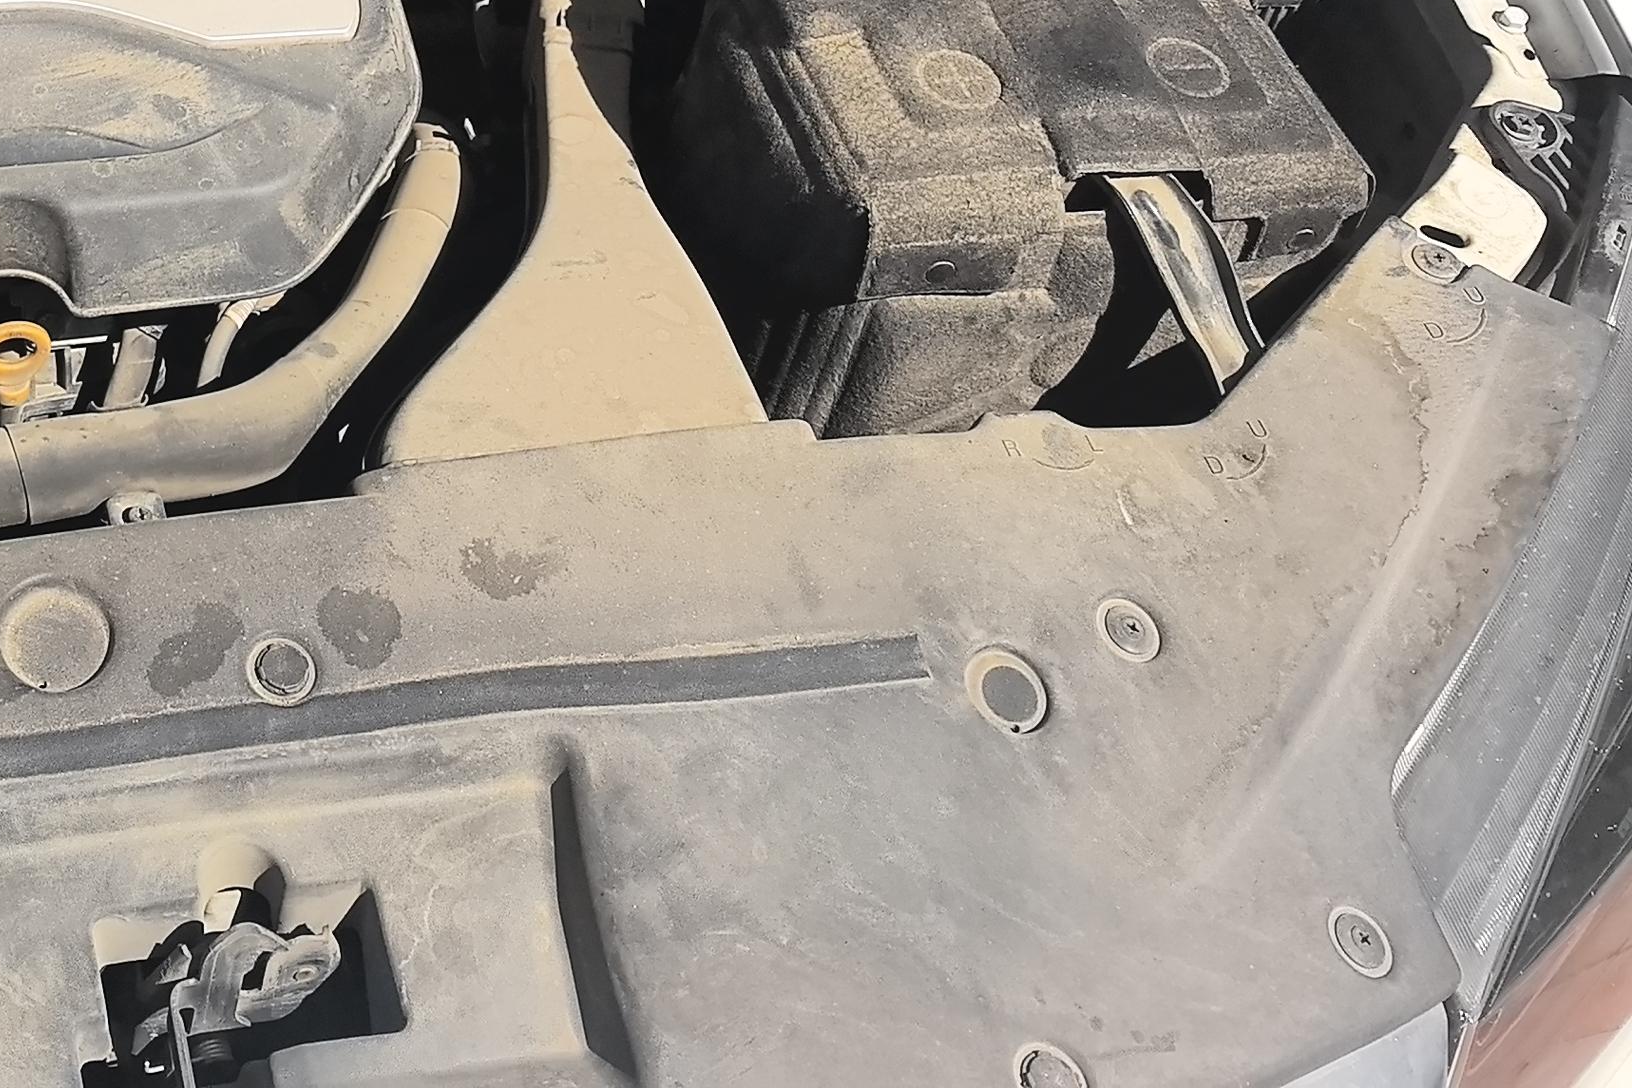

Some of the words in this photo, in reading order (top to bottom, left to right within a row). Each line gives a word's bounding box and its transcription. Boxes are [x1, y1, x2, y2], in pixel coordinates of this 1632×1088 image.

[1462, 285, 1486, 305] U
[1422, 320, 1445, 340] D
[1245, 418, 1269, 439] U
[1001, 439, 1022, 457] R
[1084, 434, 1104, 453] L
[1202, 455, 1225, 475] D
